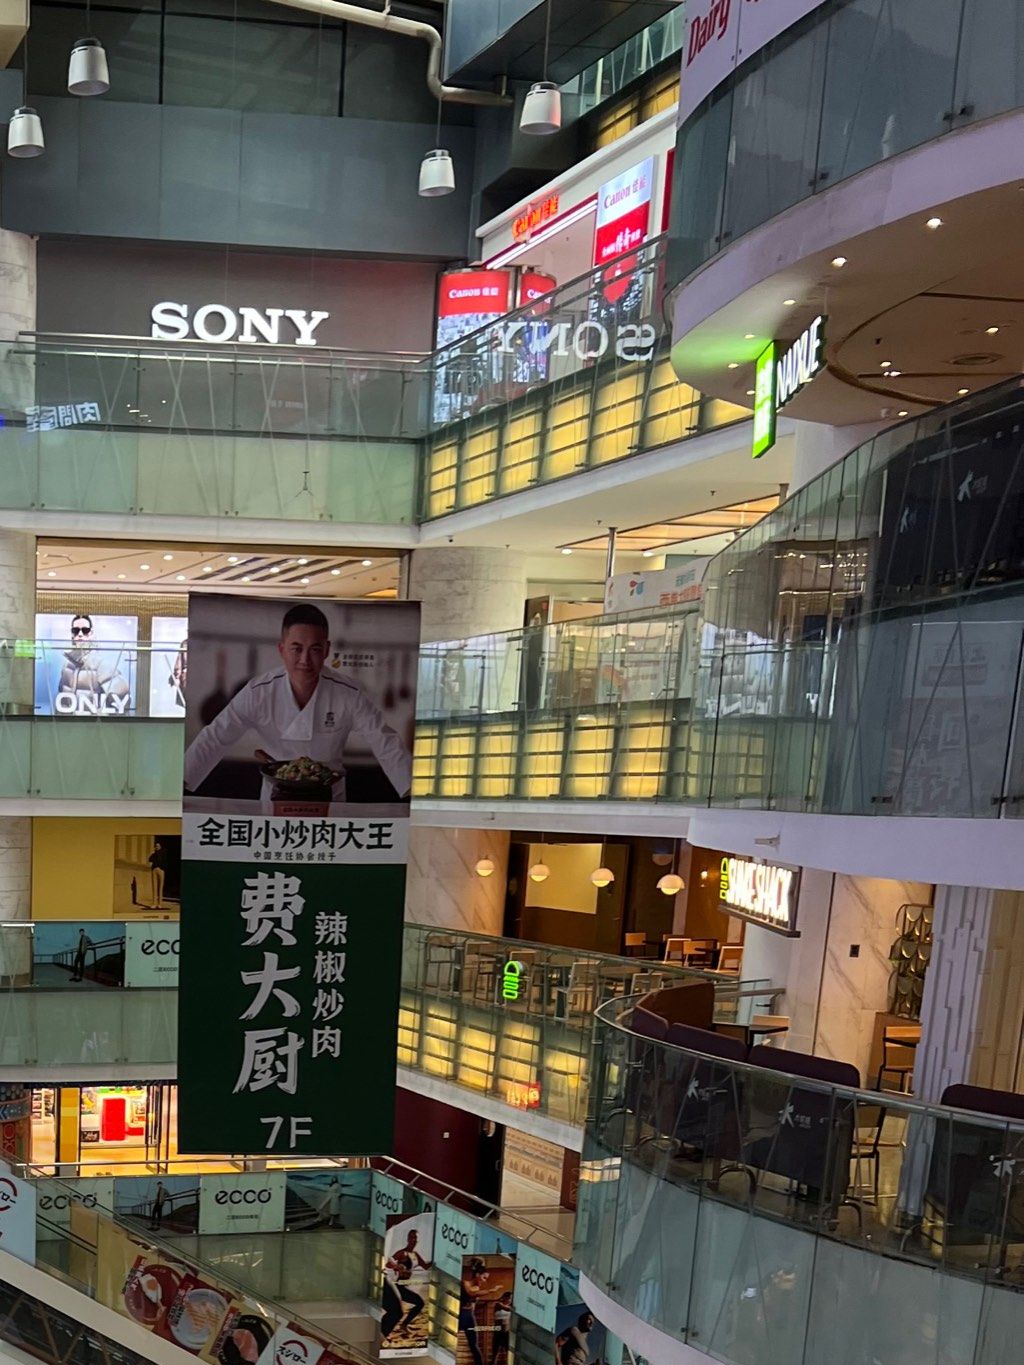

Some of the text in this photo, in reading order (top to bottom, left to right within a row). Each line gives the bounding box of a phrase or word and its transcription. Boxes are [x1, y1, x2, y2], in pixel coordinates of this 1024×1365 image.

[603, 190, 632, 209] Canon
[449, 288, 480, 299] Canon
[151, 302, 329, 345] SONY
[56, 691, 131, 714] ONLY
[197, 817, 394, 850] 全国小炒肉大王
[232, 871, 306, 1095] 费大厨
[311, 911, 348, 1058] 辣椒炒肉
[260, 1116, 313, 1149] 7F
[215, 1188, 272, 1205] ecco
[376, 1190, 399, 1213] ecco
[441, 1223, 469, 1249] ecco
[521, 1264, 554, 1294] ecco
[277, 1345, 307, 1364] スシロー
